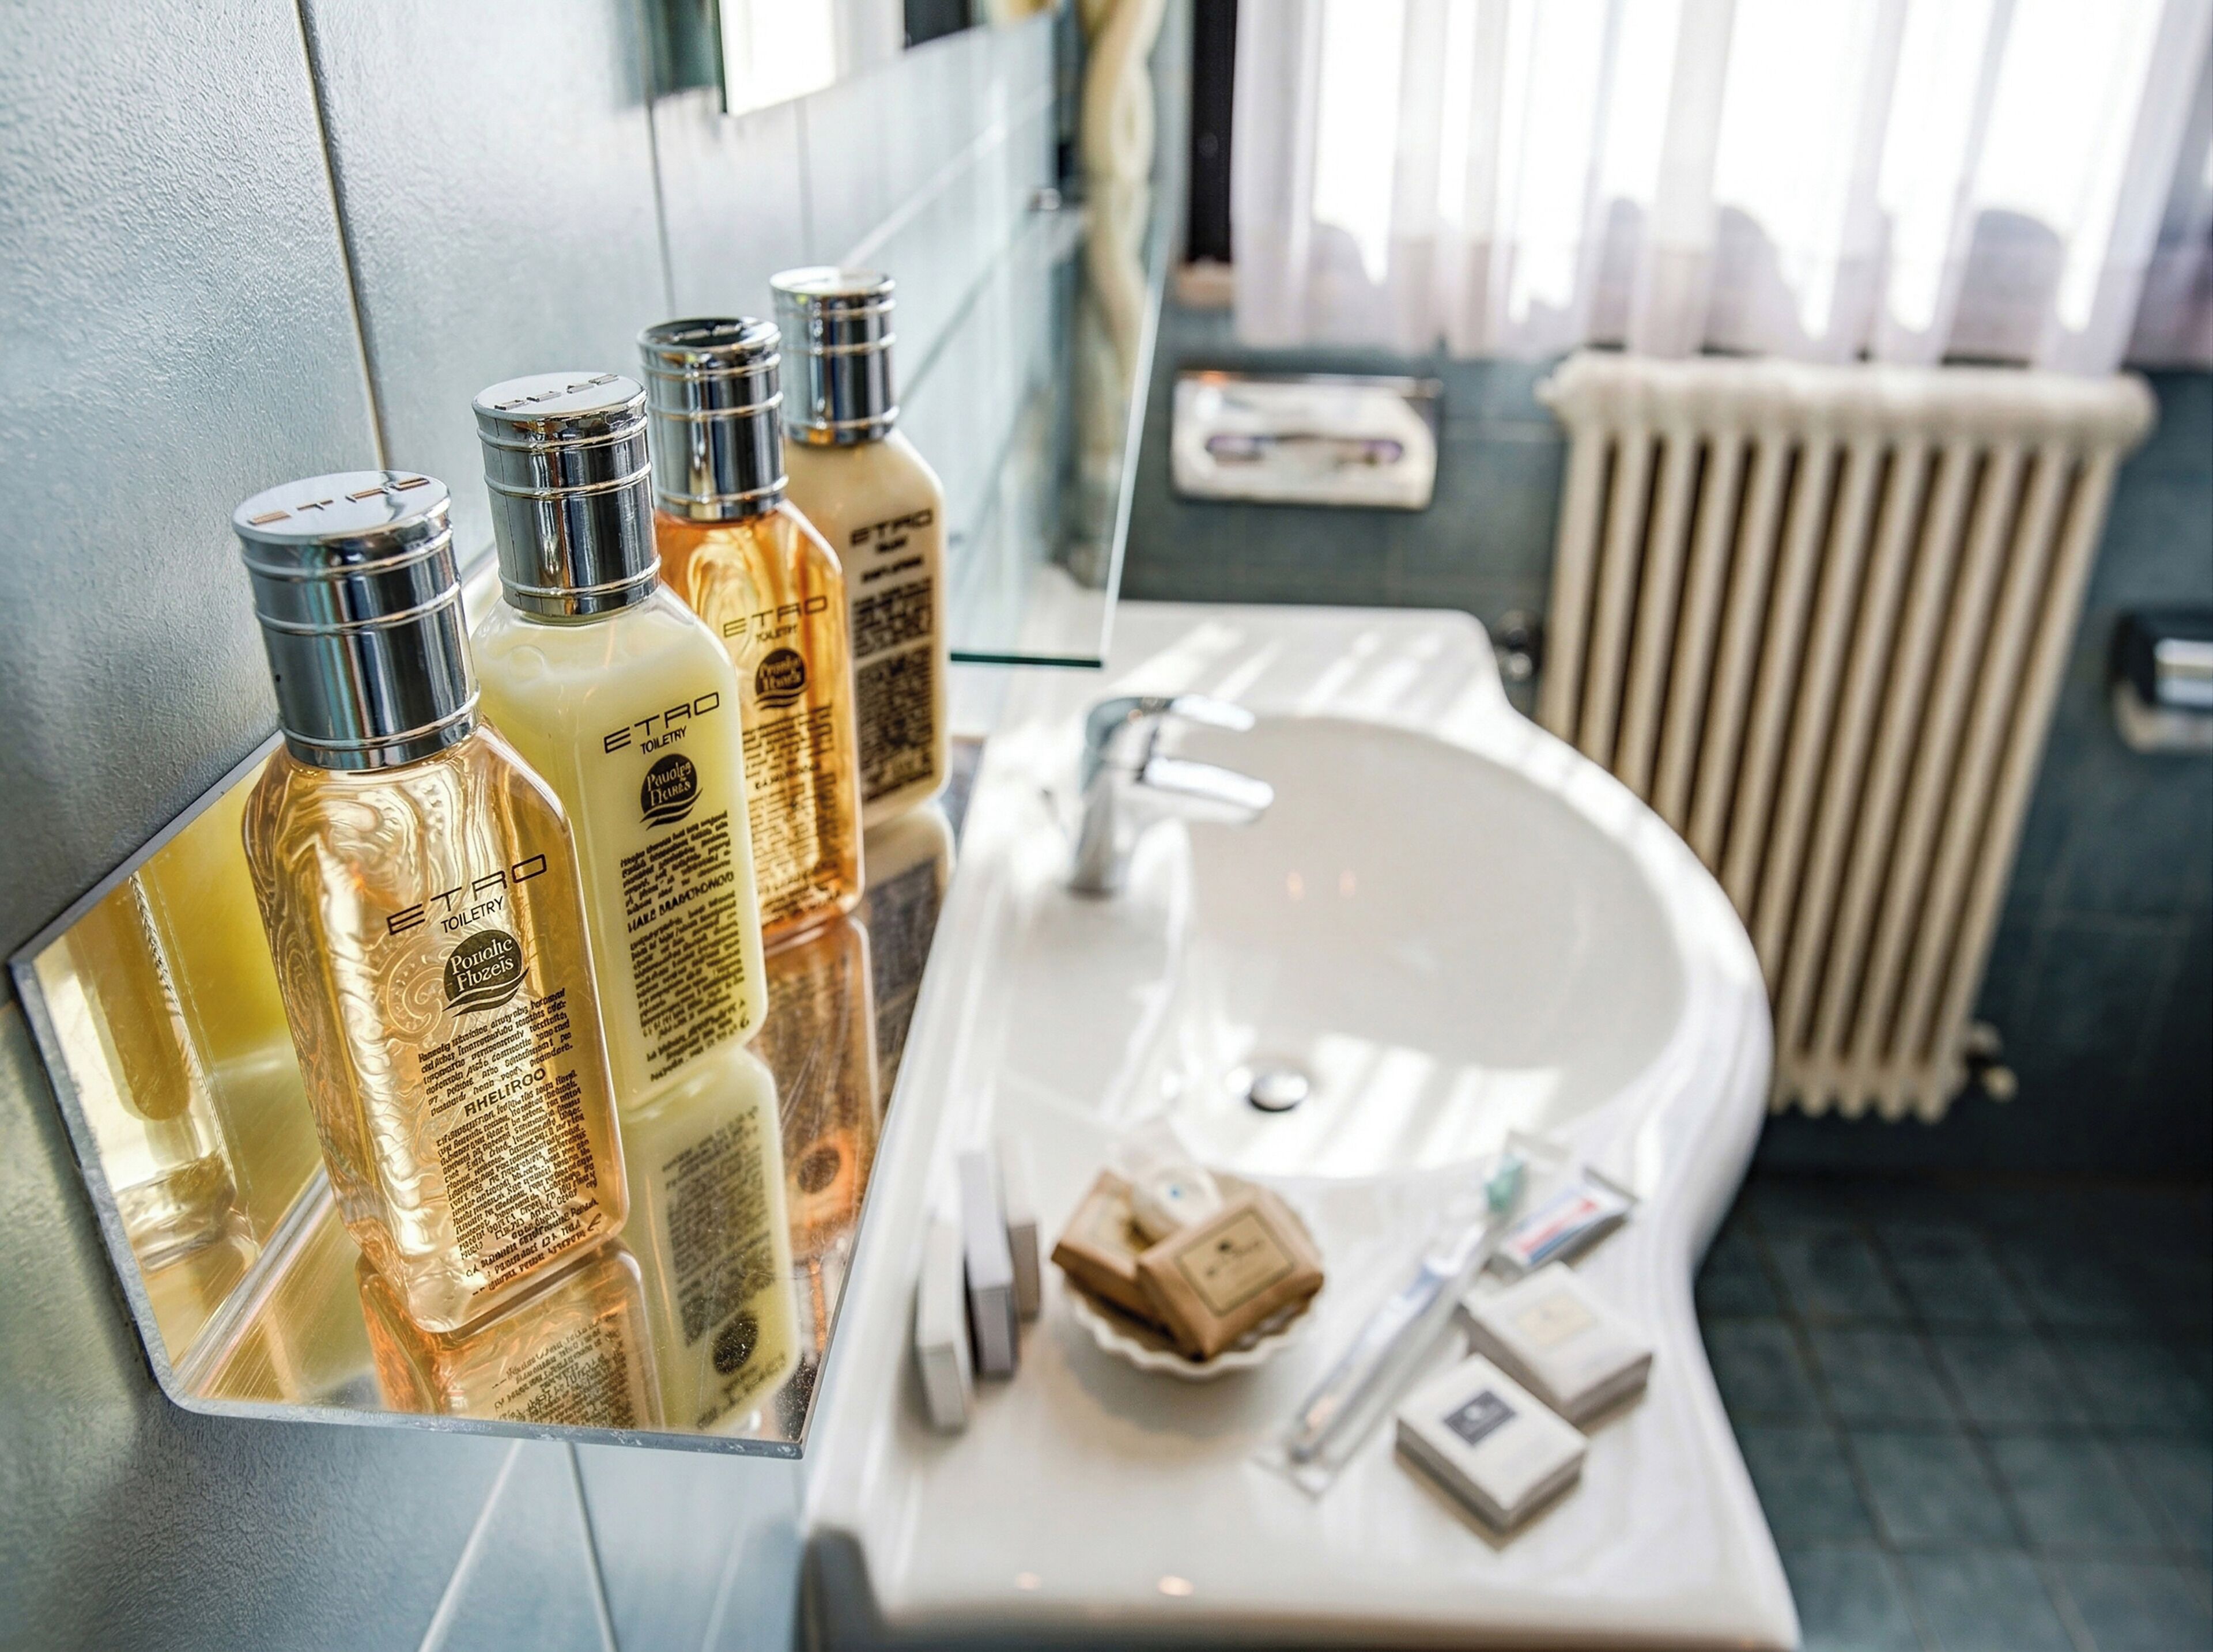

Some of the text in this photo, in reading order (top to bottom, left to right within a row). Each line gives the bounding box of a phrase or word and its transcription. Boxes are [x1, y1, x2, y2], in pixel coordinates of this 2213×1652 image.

[849, 508, 933, 547] ETRO
[723, 595, 828, 638] ETRO
[603, 691, 720, 754] ETRO
[386, 853, 547, 936] ETRO
[440, 896, 504, 933] TOILETRY
